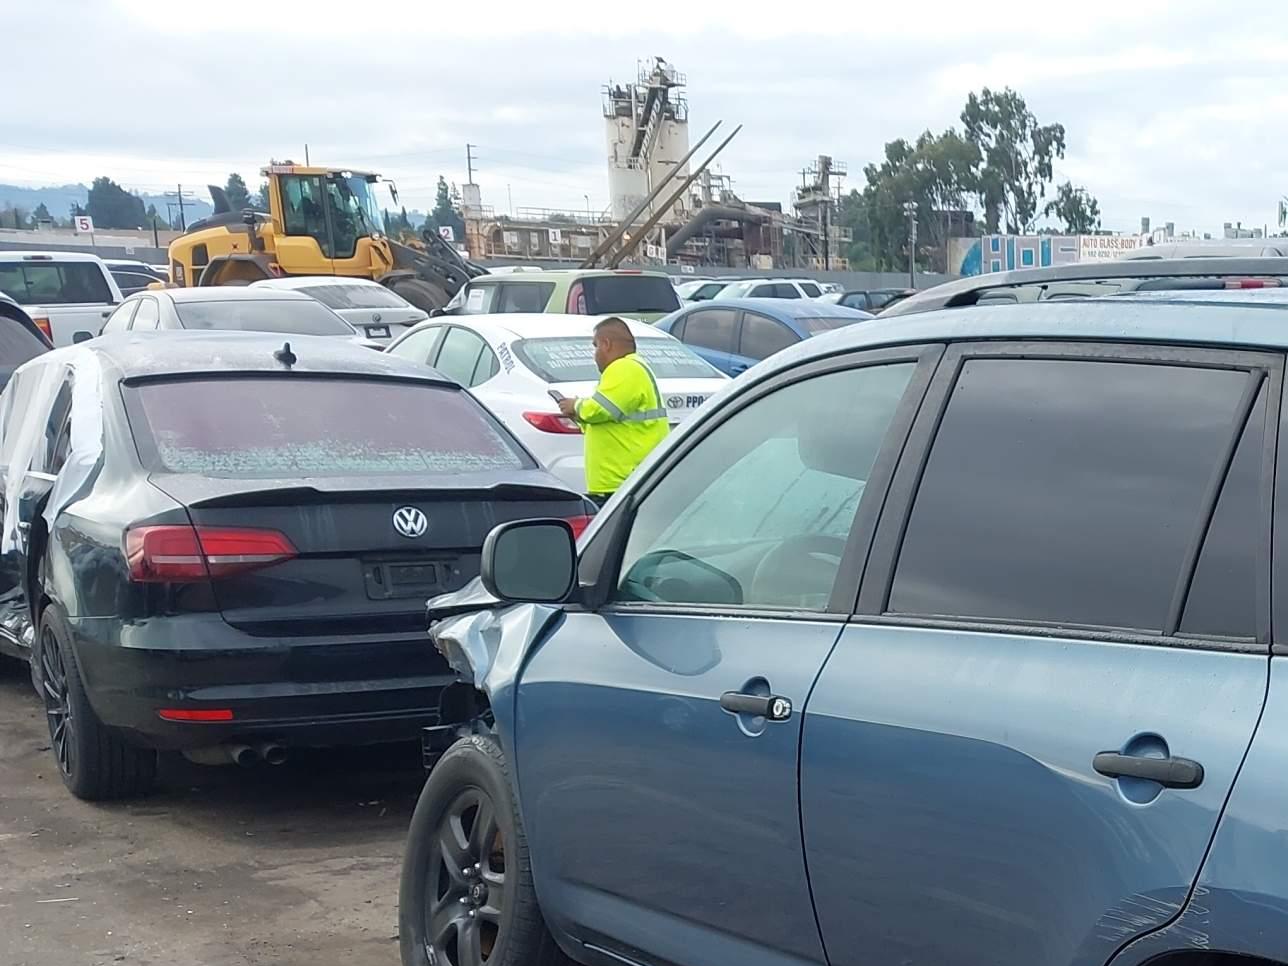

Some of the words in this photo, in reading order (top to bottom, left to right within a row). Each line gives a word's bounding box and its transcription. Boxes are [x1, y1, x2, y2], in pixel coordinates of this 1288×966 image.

[80, 218, 89, 231] 5
[441, 228, 450, 240] 2
[552, 230, 560, 242] 1
[1082, 238, 1098, 249] AUTO
